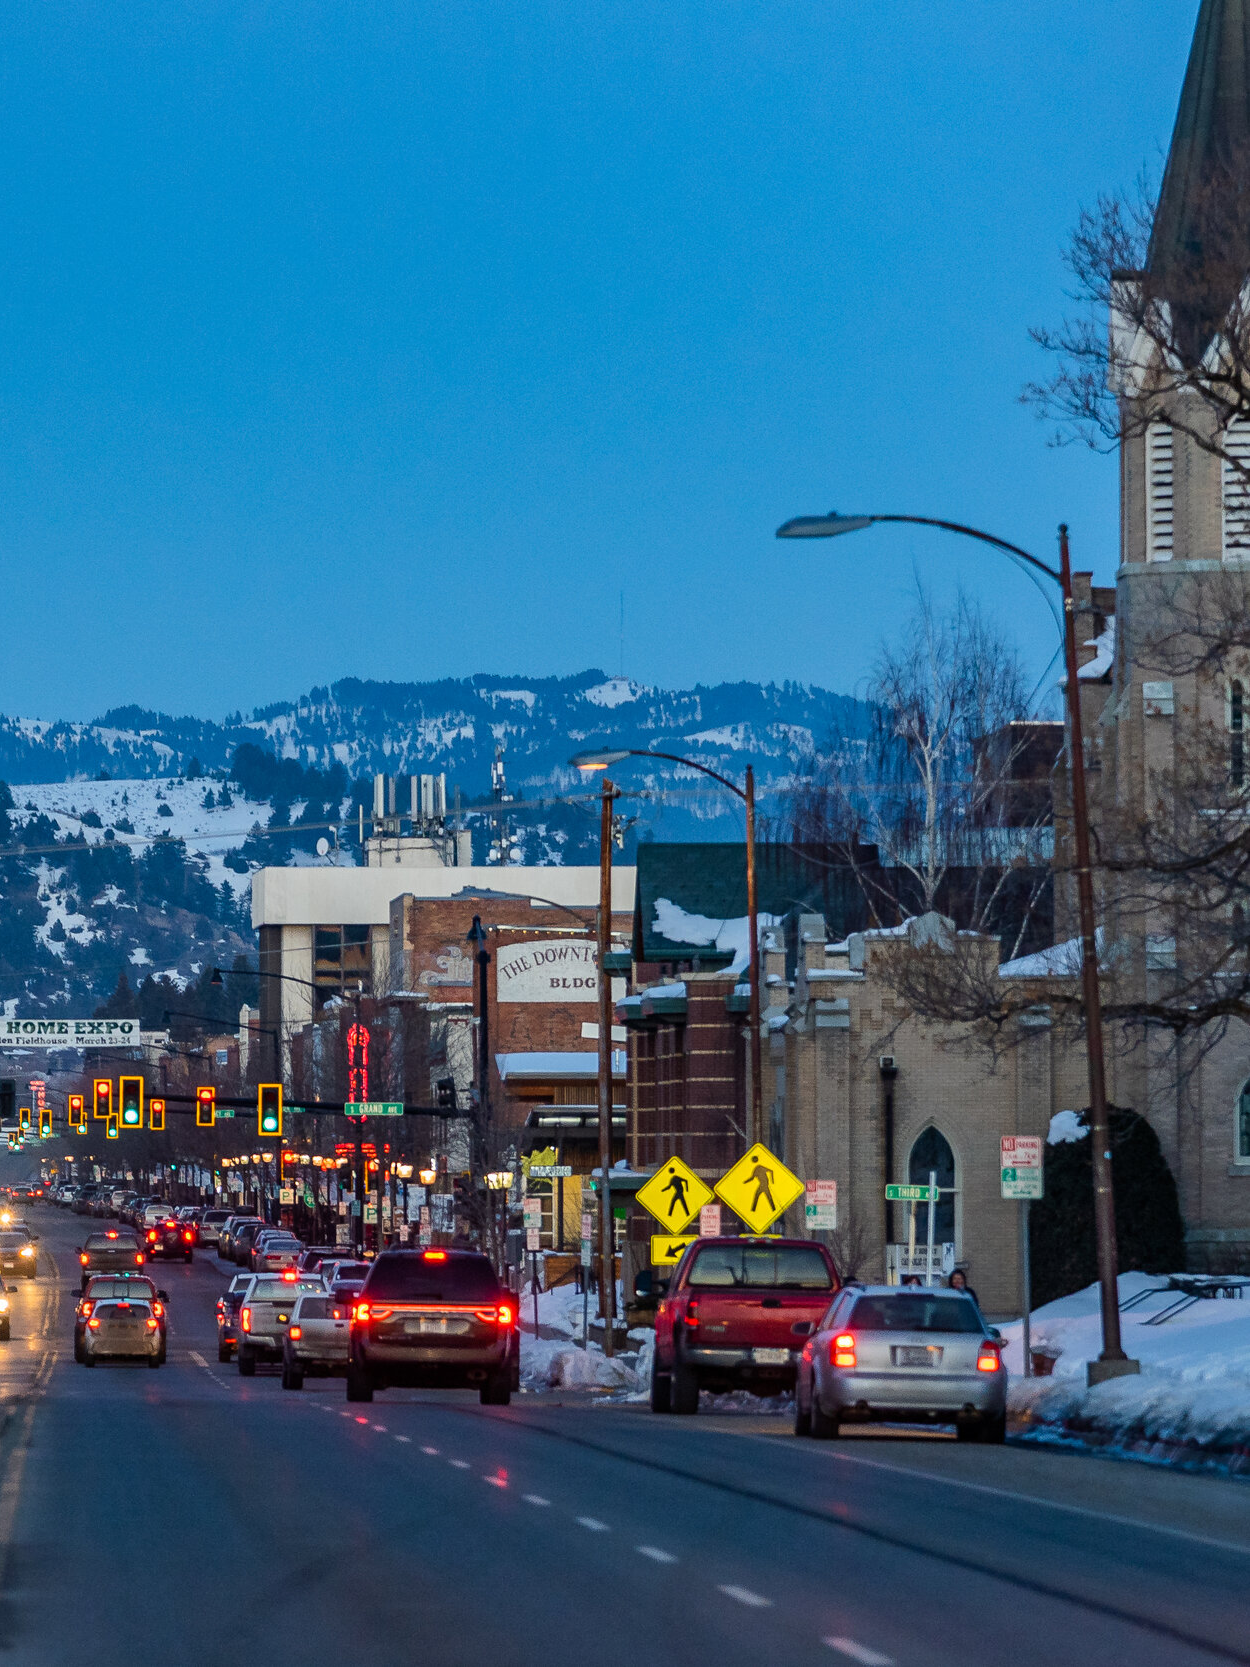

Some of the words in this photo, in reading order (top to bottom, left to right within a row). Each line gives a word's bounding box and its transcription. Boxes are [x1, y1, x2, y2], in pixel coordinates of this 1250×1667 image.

[500, 956, 531, 980] THE
[550, 977, 596, 988] BLDG
[6, 1021, 69, 1034] HOME
[74, 1021, 134, 1034] EXPO
[15, 1036, 68, 1045] Fieldhouse
[75, 1036, 107, 1045] March
[359, 1104, 383, 1114] GRAND
[1002, 1138, 1016, 1151] NO
[898, 1187, 920, 1198] THIRD
